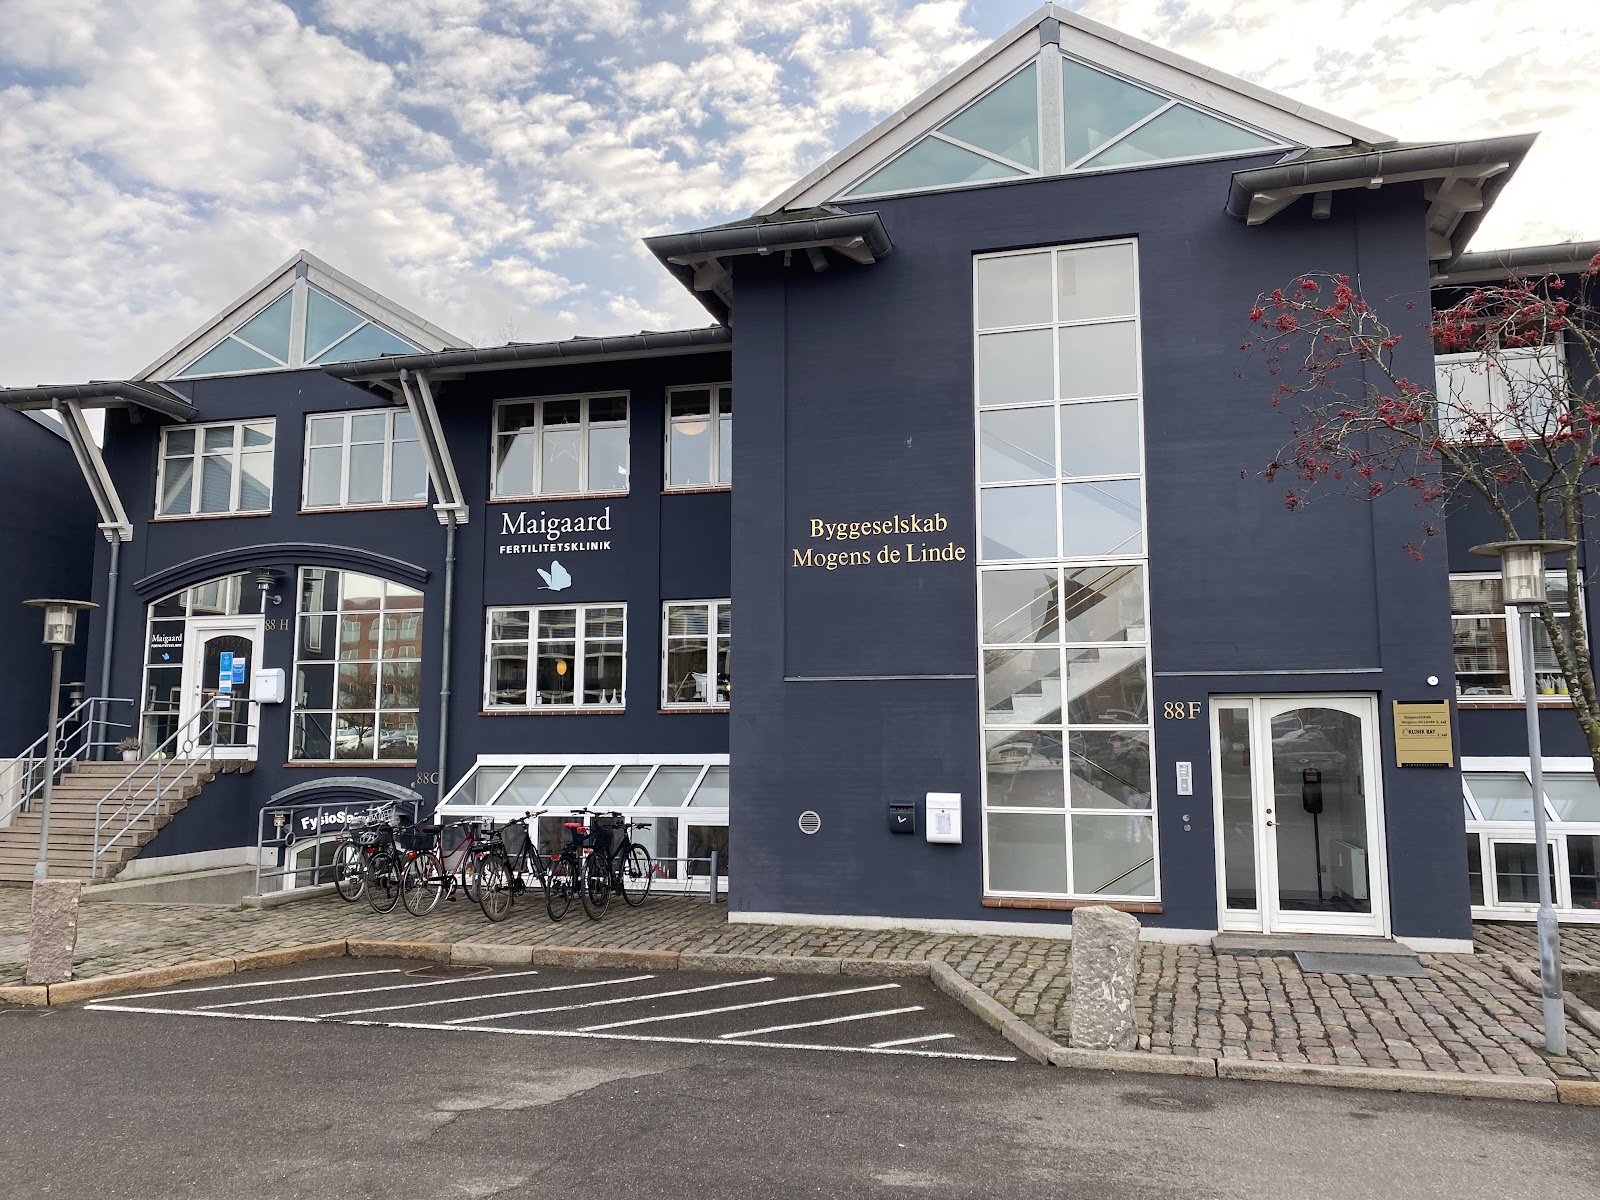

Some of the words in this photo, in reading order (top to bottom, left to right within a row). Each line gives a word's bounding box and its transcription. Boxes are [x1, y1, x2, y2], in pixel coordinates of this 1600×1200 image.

[500, 507, 611, 540] Maigaard
[810, 513, 948, 540] Byggeselskab
[500, 541, 611, 554] FERTILITETSKLINIK
[792, 549, 871, 570] Mogens
[876, 545, 901, 564] de
[906, 542, 966, 563] Linde
[265, 619, 276, 631] 88
[279, 619, 290, 631] H
[152, 633, 183, 644] Maigaard
